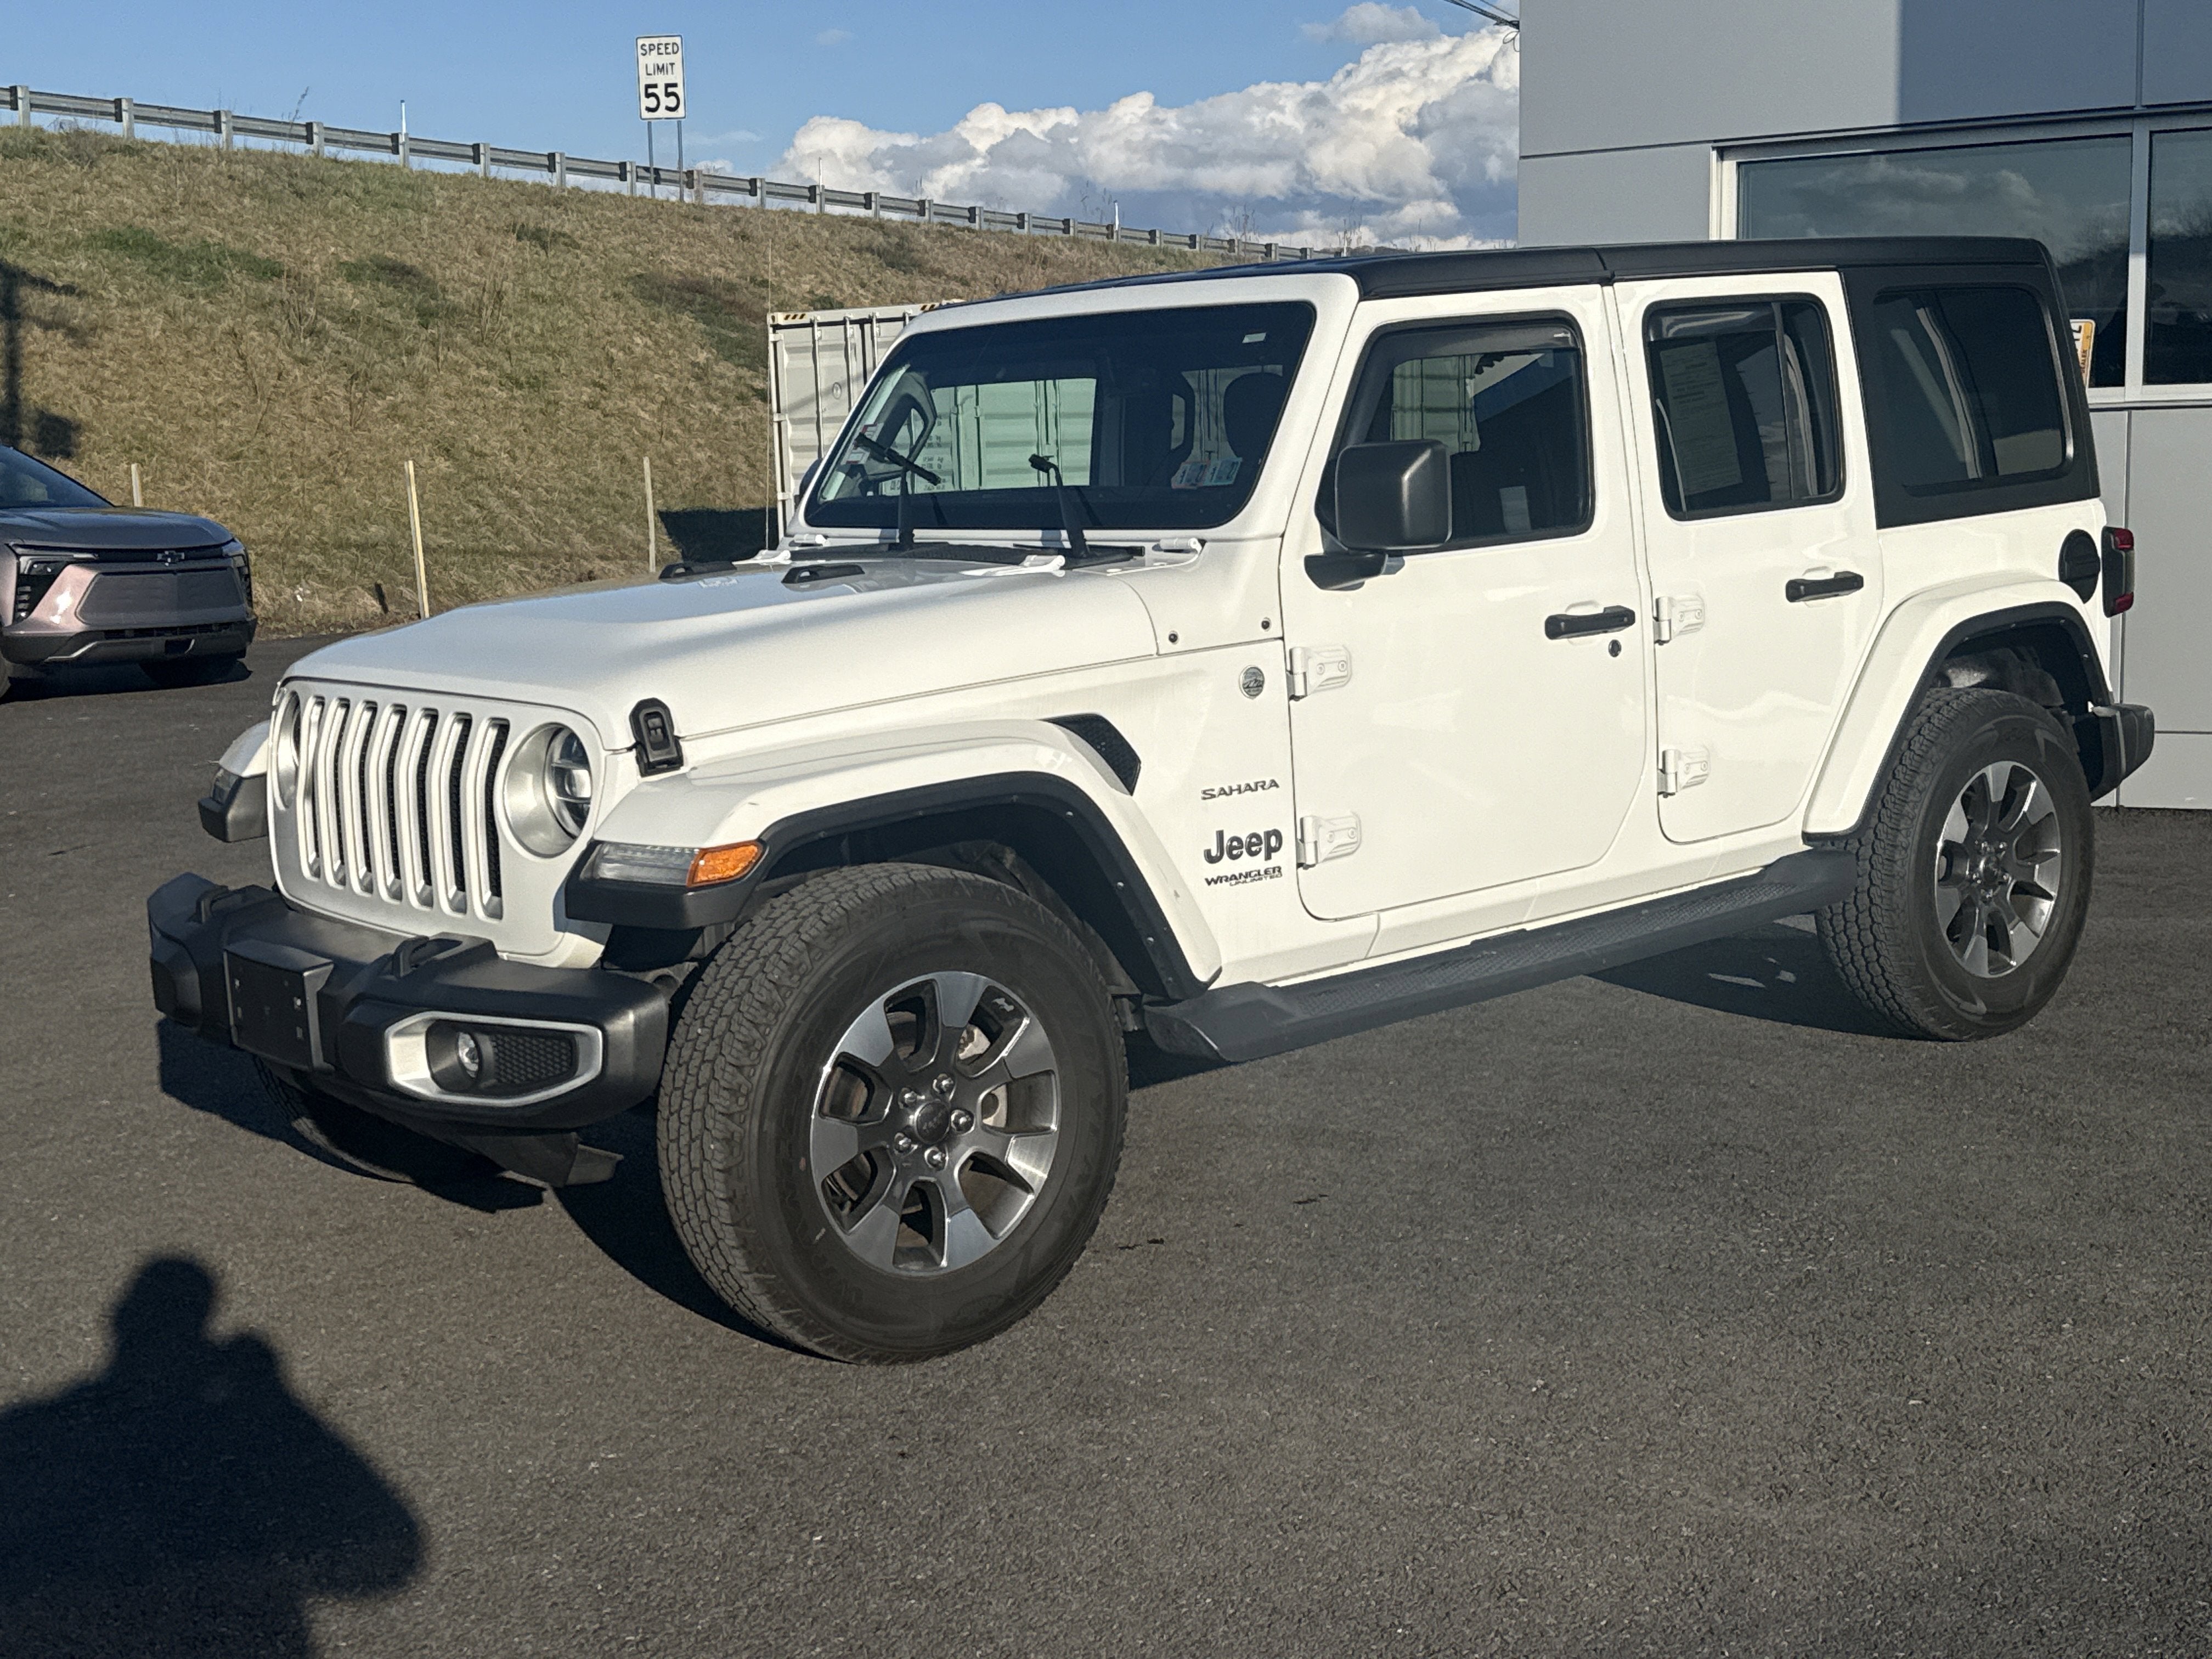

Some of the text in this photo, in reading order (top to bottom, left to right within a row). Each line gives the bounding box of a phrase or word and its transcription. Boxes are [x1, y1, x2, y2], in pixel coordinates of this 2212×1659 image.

[640, 42, 679, 56] SPEED
[645, 63, 675, 76] LIMIT
[644, 83, 680, 112] 55
[1201, 779, 1279, 800] SAHARA
[1204, 828, 1283, 864] Jeep
[1205, 866, 1282, 886] WRANGLER
